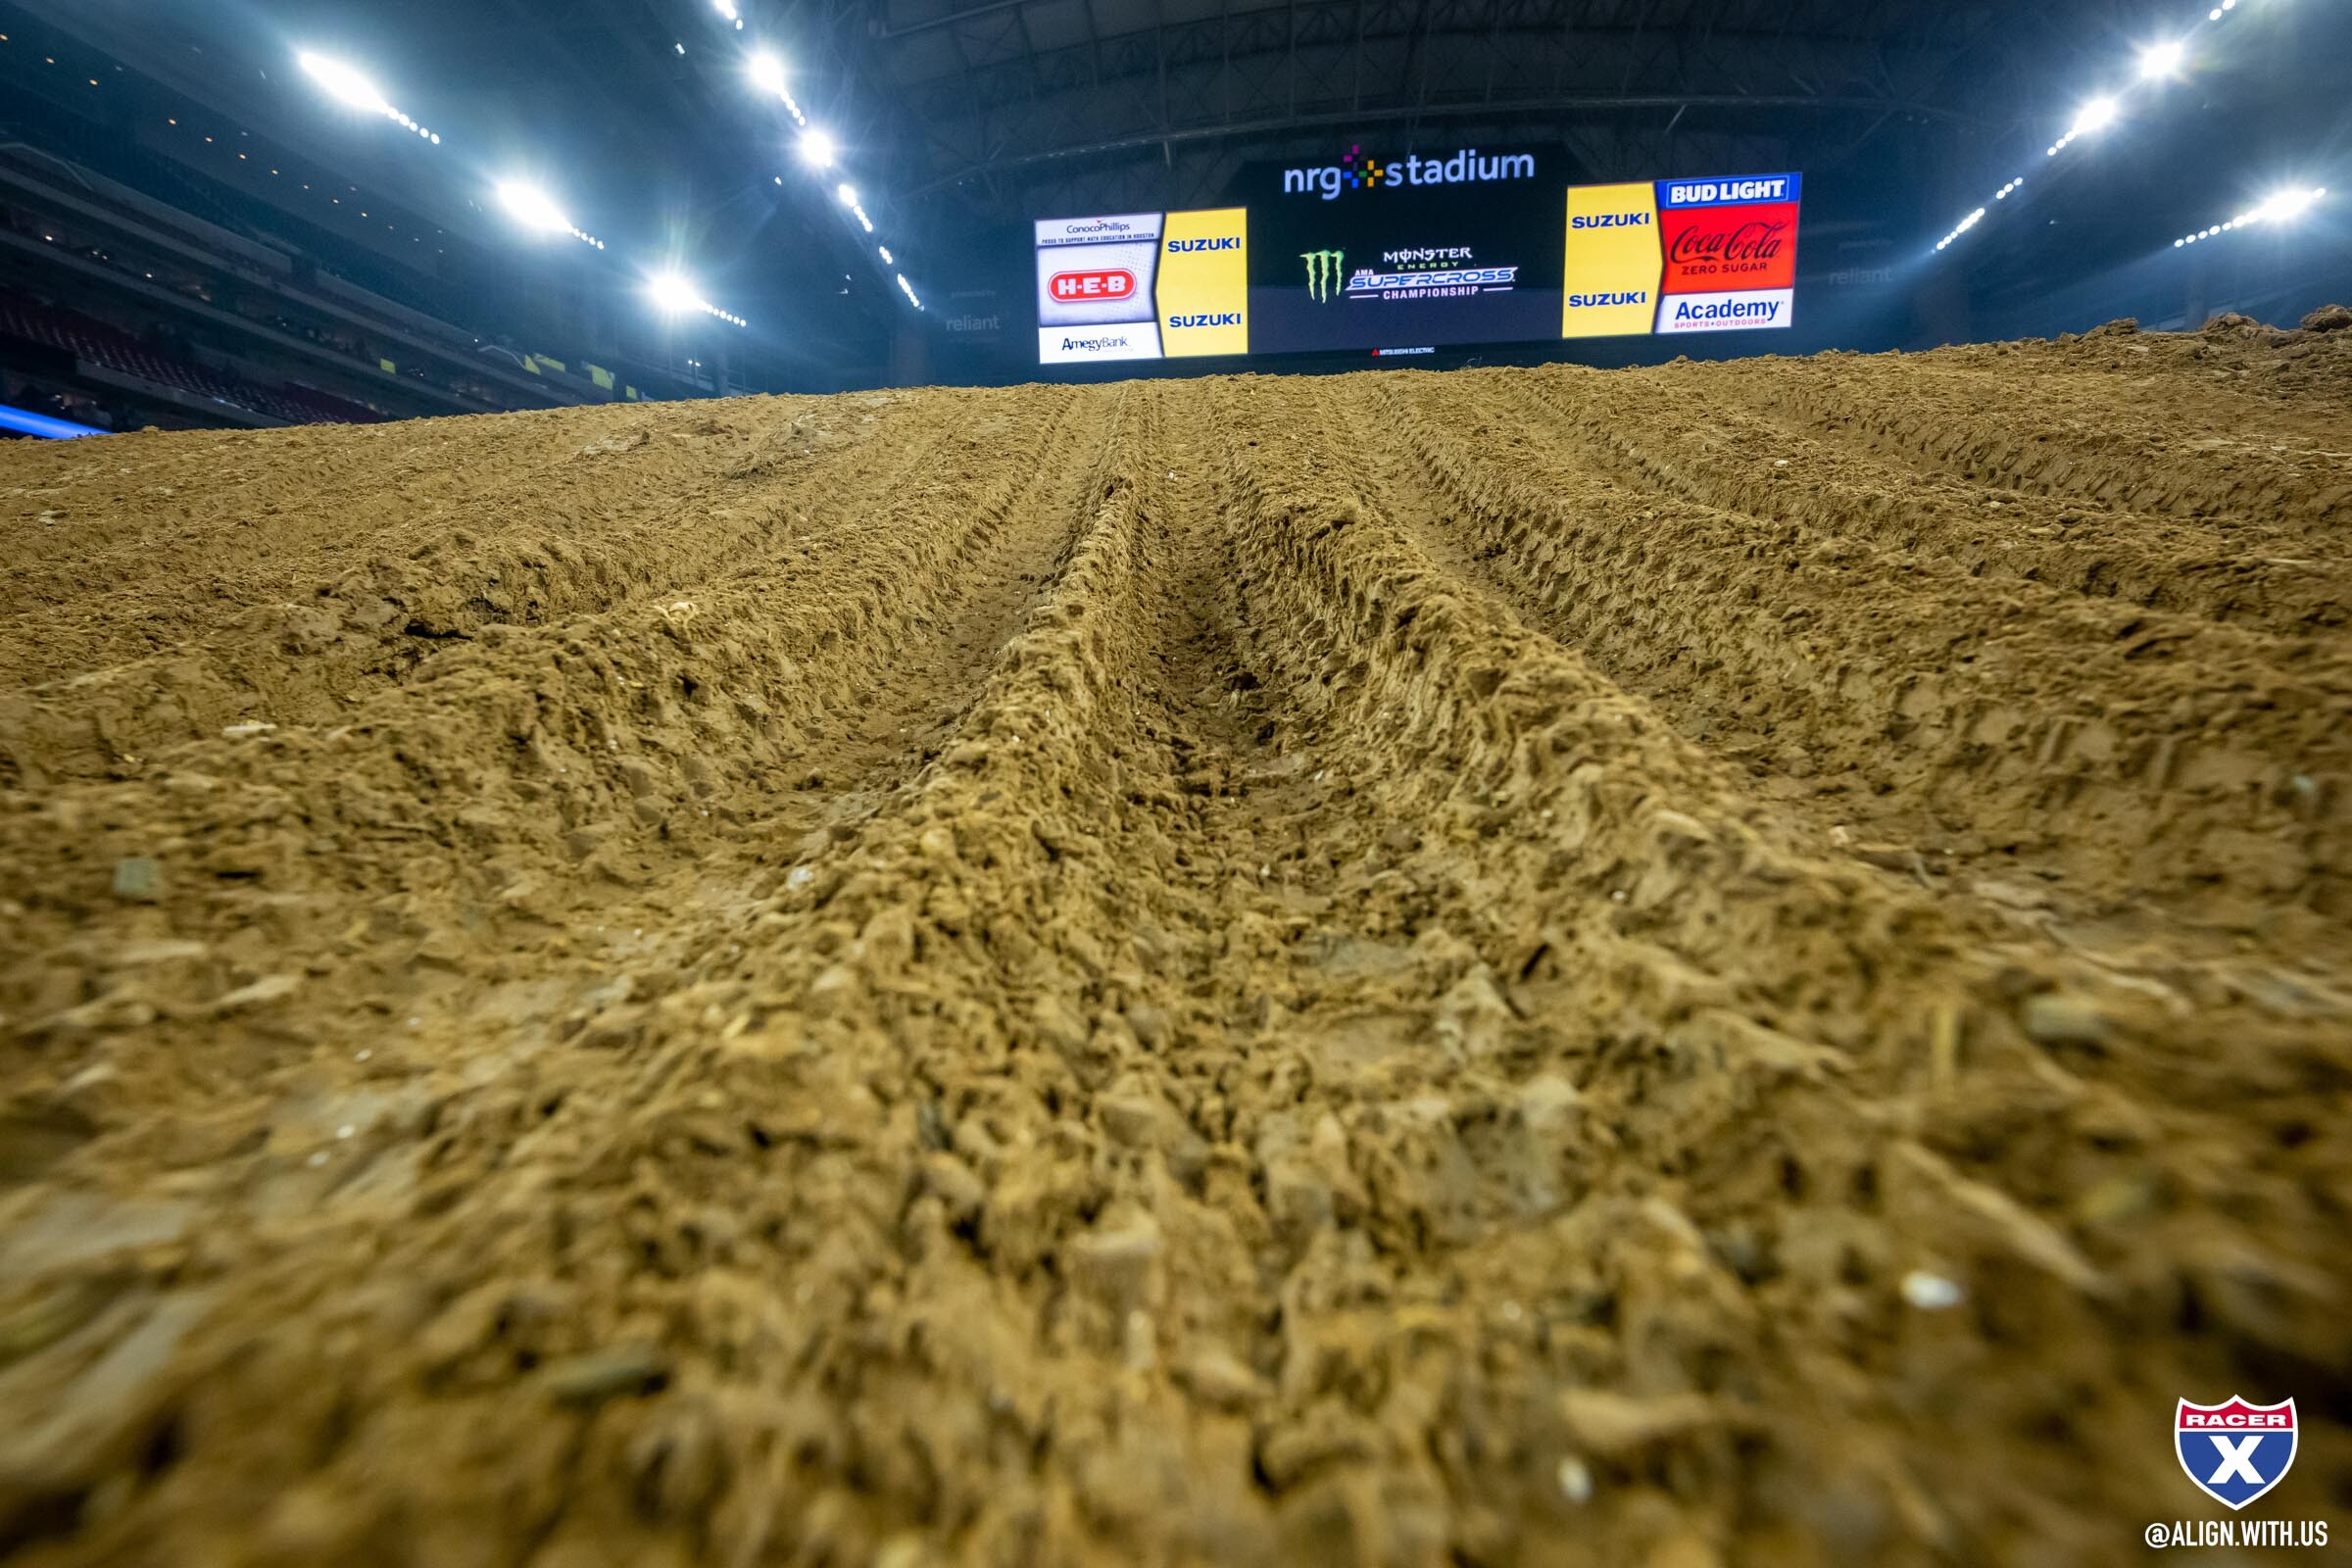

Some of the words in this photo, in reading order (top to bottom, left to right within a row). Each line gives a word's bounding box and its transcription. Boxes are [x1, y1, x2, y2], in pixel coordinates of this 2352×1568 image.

[1284, 166, 1341, 200] nrg
[1385, 149, 1534, 186] stadium
[1671, 186, 1718, 204] BUD
[1719, 179, 1785, 200] LIGHT
[1066, 221, 1130, 234] ConocoPhillips
[1571, 213, 1650, 229] SUZUKI
[1167, 237, 1241, 253] SUZUKI
[1383, 247, 1473, 264] MONSTER
[1396, 261, 1459, 270] ENERGY
[1681, 265, 1718, 275] ZERO
[1722, 263, 1768, 273] SUGAR
[1349, 271, 1513, 288] SUPERCROSS
[1383, 286, 1479, 300] CHAMPIONSHIP
[1569, 292, 1646, 308] SUZUKI
[1675, 299, 1780, 321] Academy
[946, 315, 1001, 331] reliant
[1169, 314, 1242, 328] SUZUKI
[1716, 318, 1767, 327] OUTDOORS
[1061, 336, 1128, 352] AmegyBank
